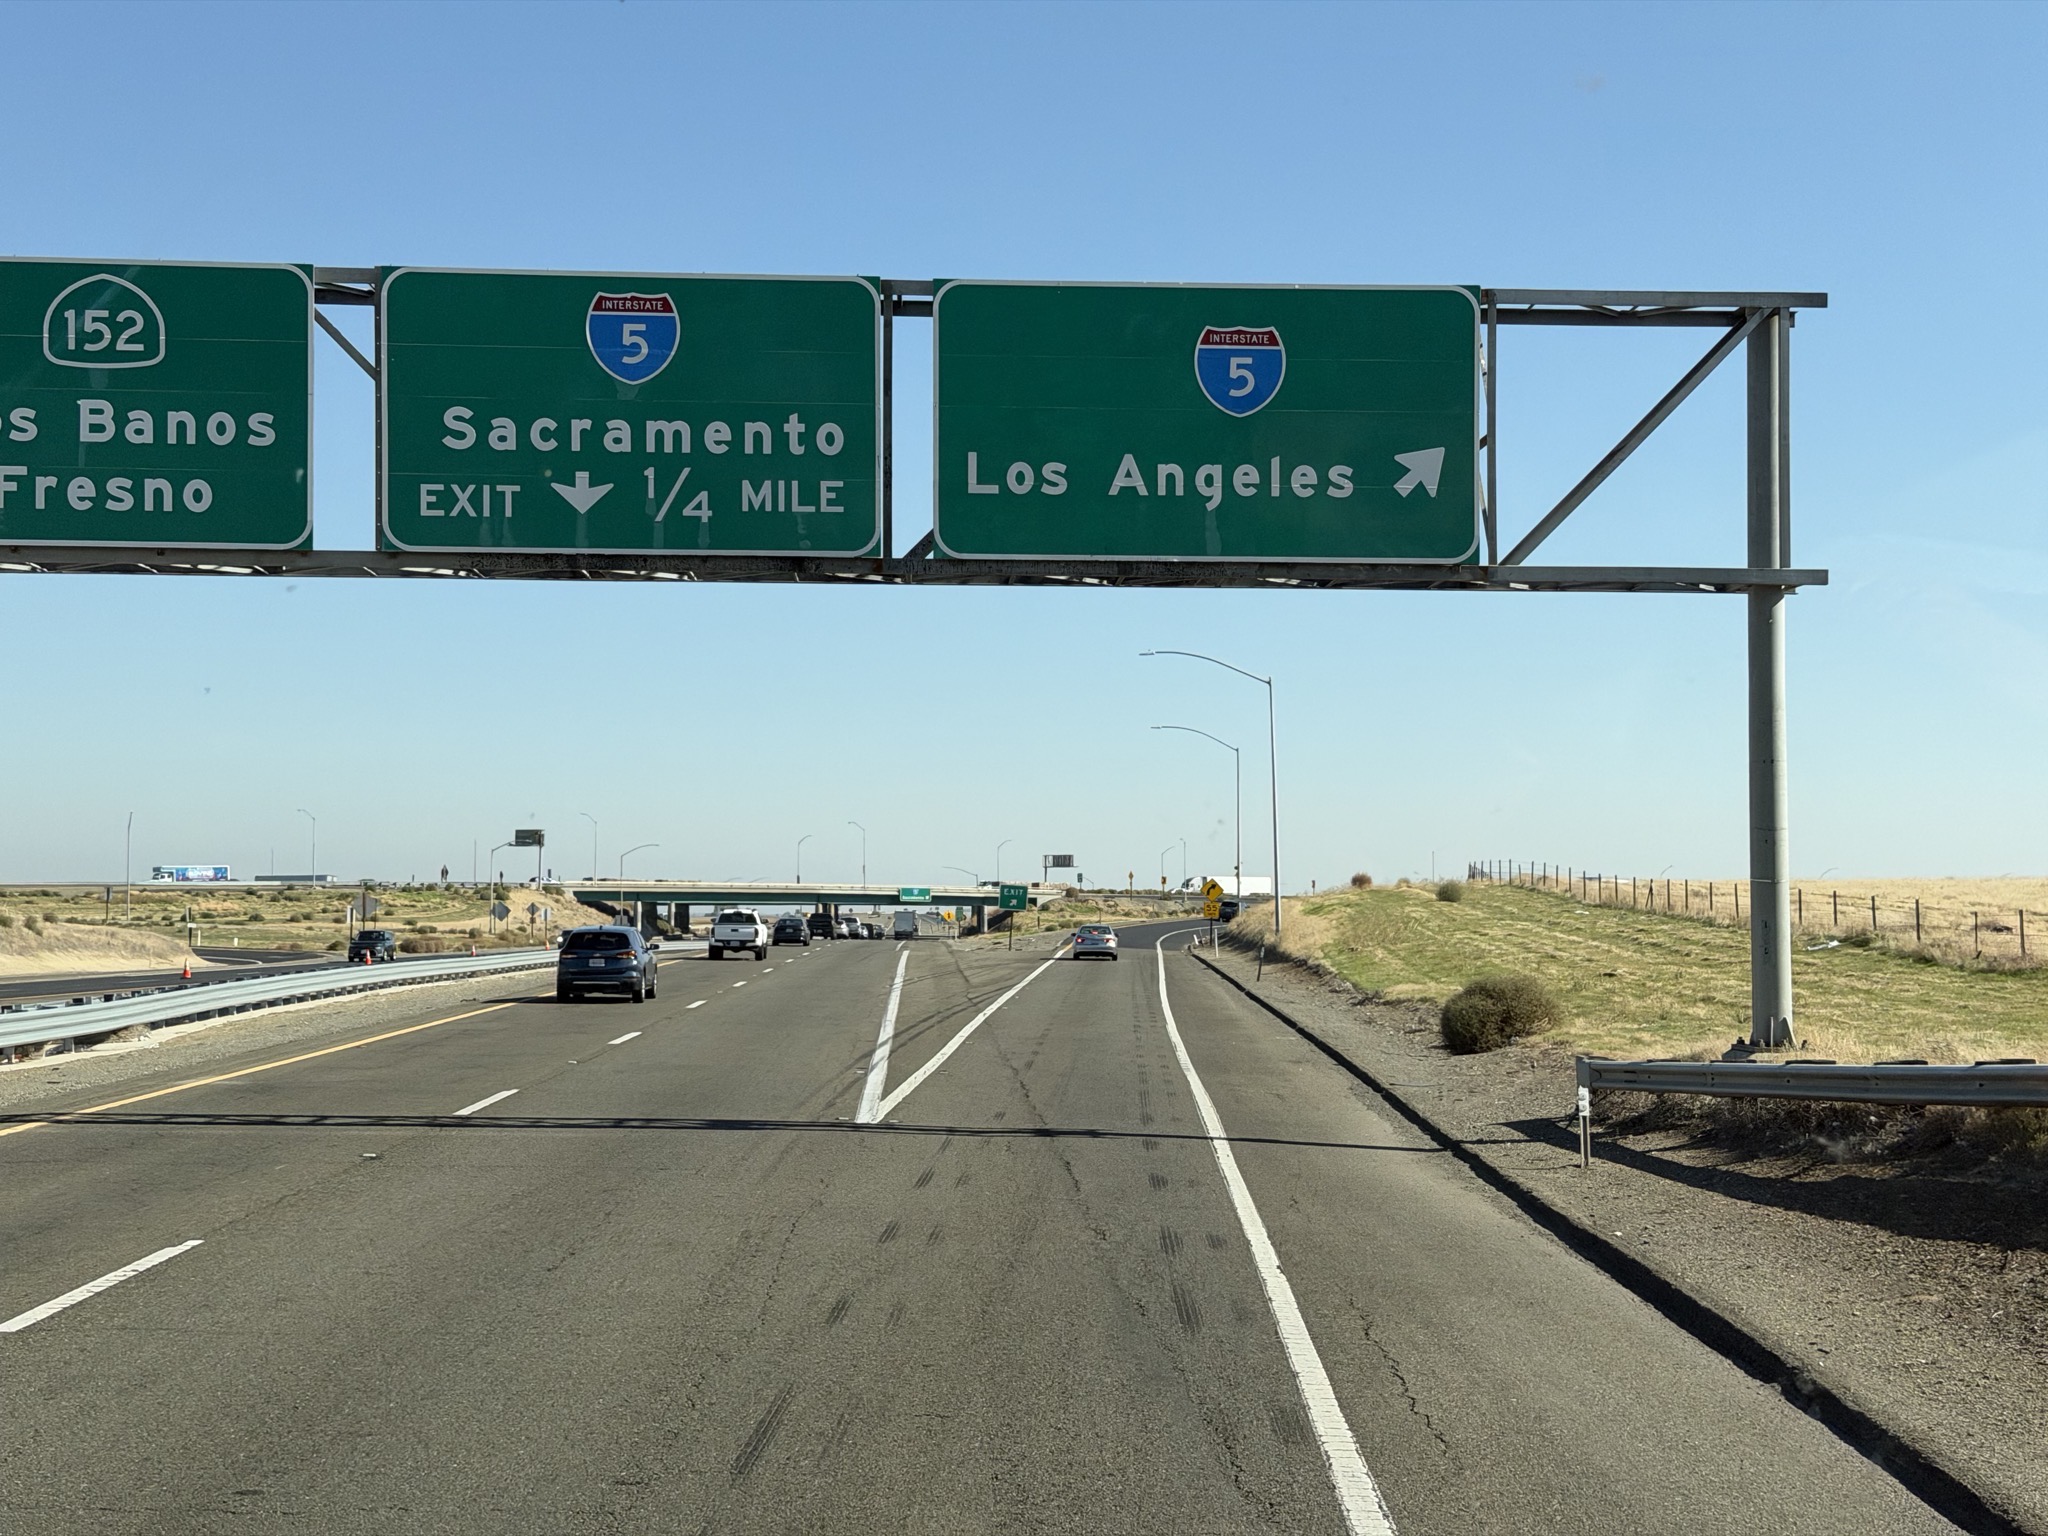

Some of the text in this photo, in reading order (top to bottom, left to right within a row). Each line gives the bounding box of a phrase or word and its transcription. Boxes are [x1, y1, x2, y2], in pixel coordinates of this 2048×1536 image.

[602, 299, 664, 311] INTERSTATE
[64, 309, 145, 351] 152
[621, 323, 649, 365] 5
[1209, 333, 1270, 344] INTERSTATE
[1228, 356, 1255, 397] 5
[0, 399, 276, 446] s Banos
[441, 406, 845, 456] Sacramento
[0, 465, 213, 513] Fresno
[420, 466, 845, 523] EXIT 1/4 MILE
[967, 451, 1354, 511] Los Angeles
[1004, 888, 1024, 896] EXIT
[1206, 904, 1218, 912] 55
